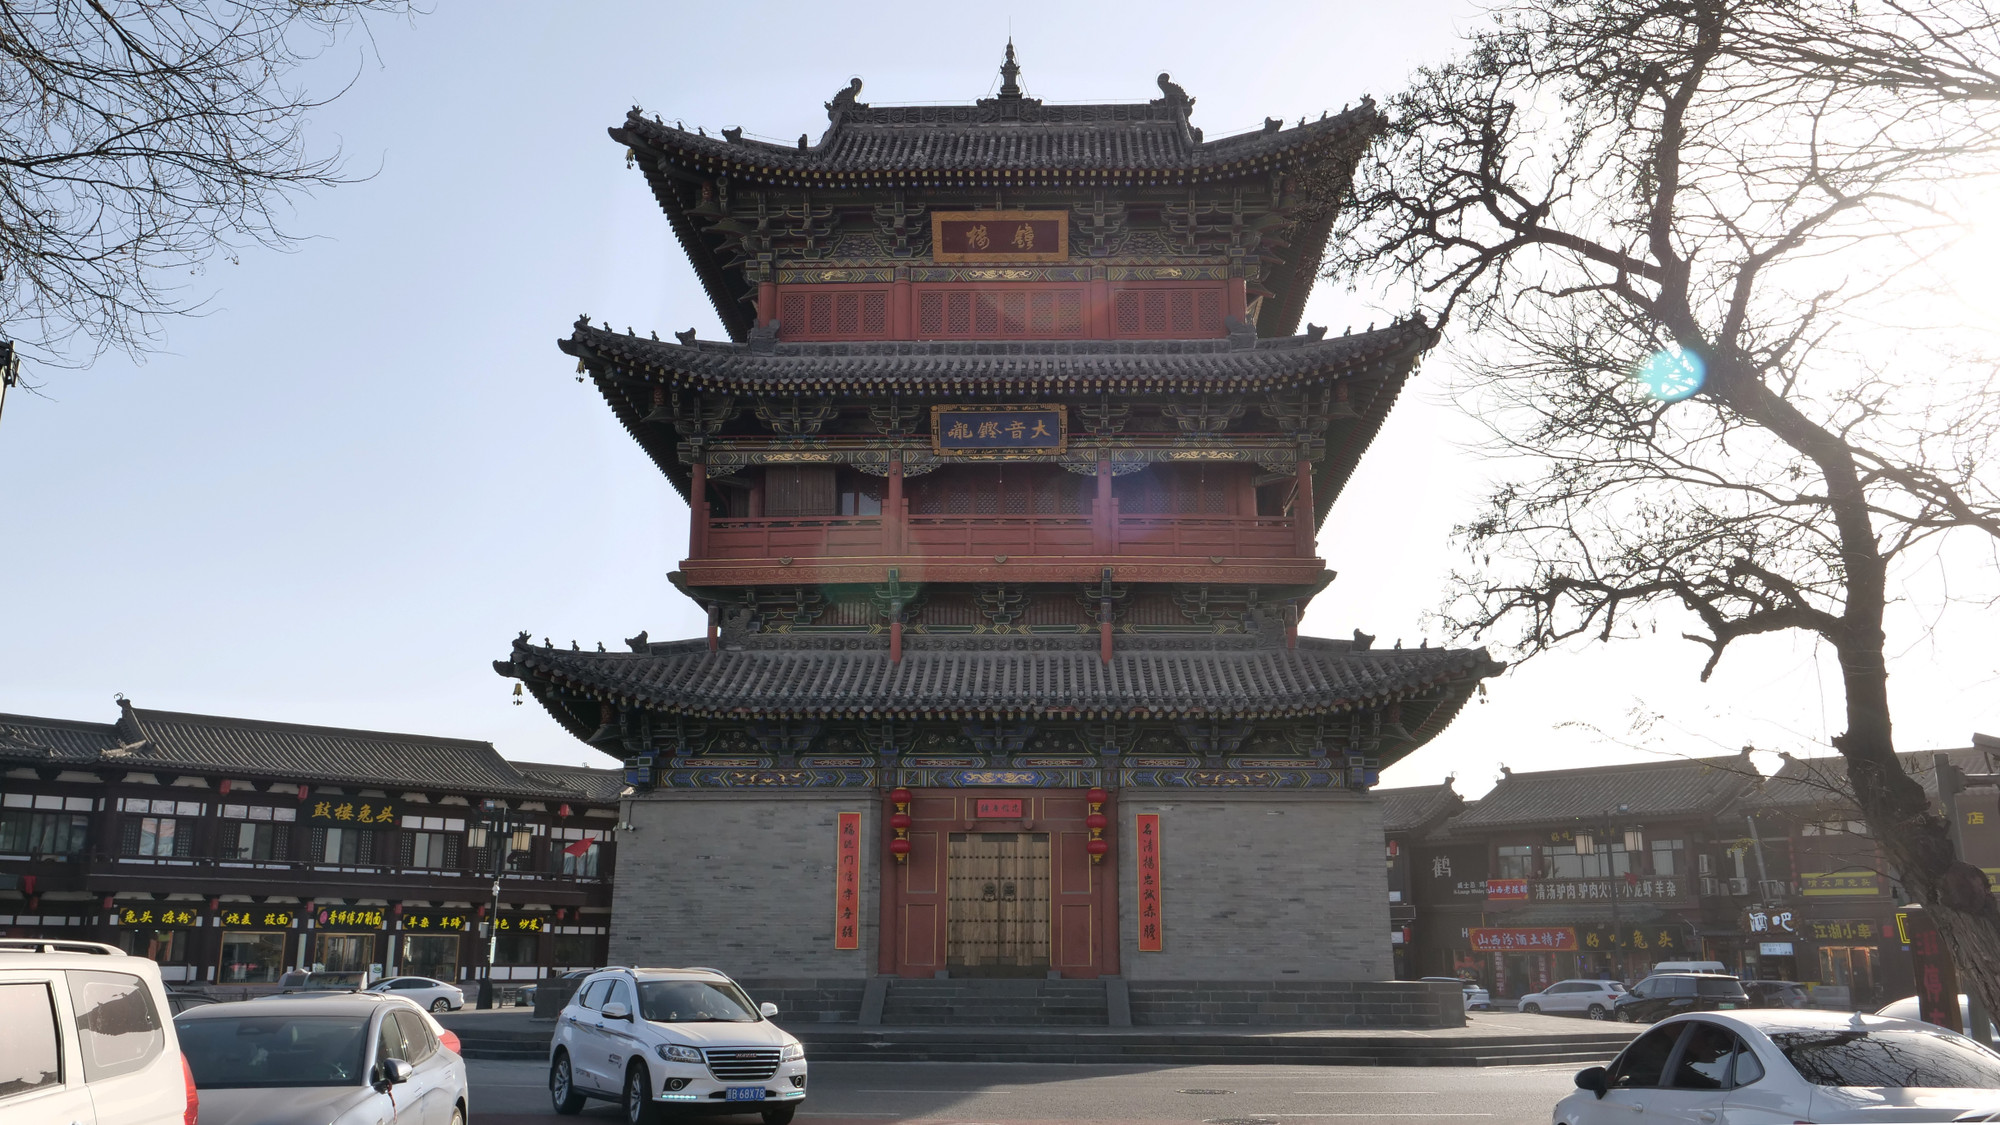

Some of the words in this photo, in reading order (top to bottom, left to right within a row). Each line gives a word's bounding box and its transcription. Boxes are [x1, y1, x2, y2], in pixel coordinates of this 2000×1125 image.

[311, 801, 394, 823] 鼓楼兔头
[1535, 883, 1576, 900] 清汤驴肉
[1655, 880, 1677, 898] 羊杂
[125, 910, 153, 923] 兔头
[519, 918, 539, 930] 炒菜
[1749, 912, 1793, 931] 酒吧
[1477, 932, 1566, 947] 山西汾酒土特产
